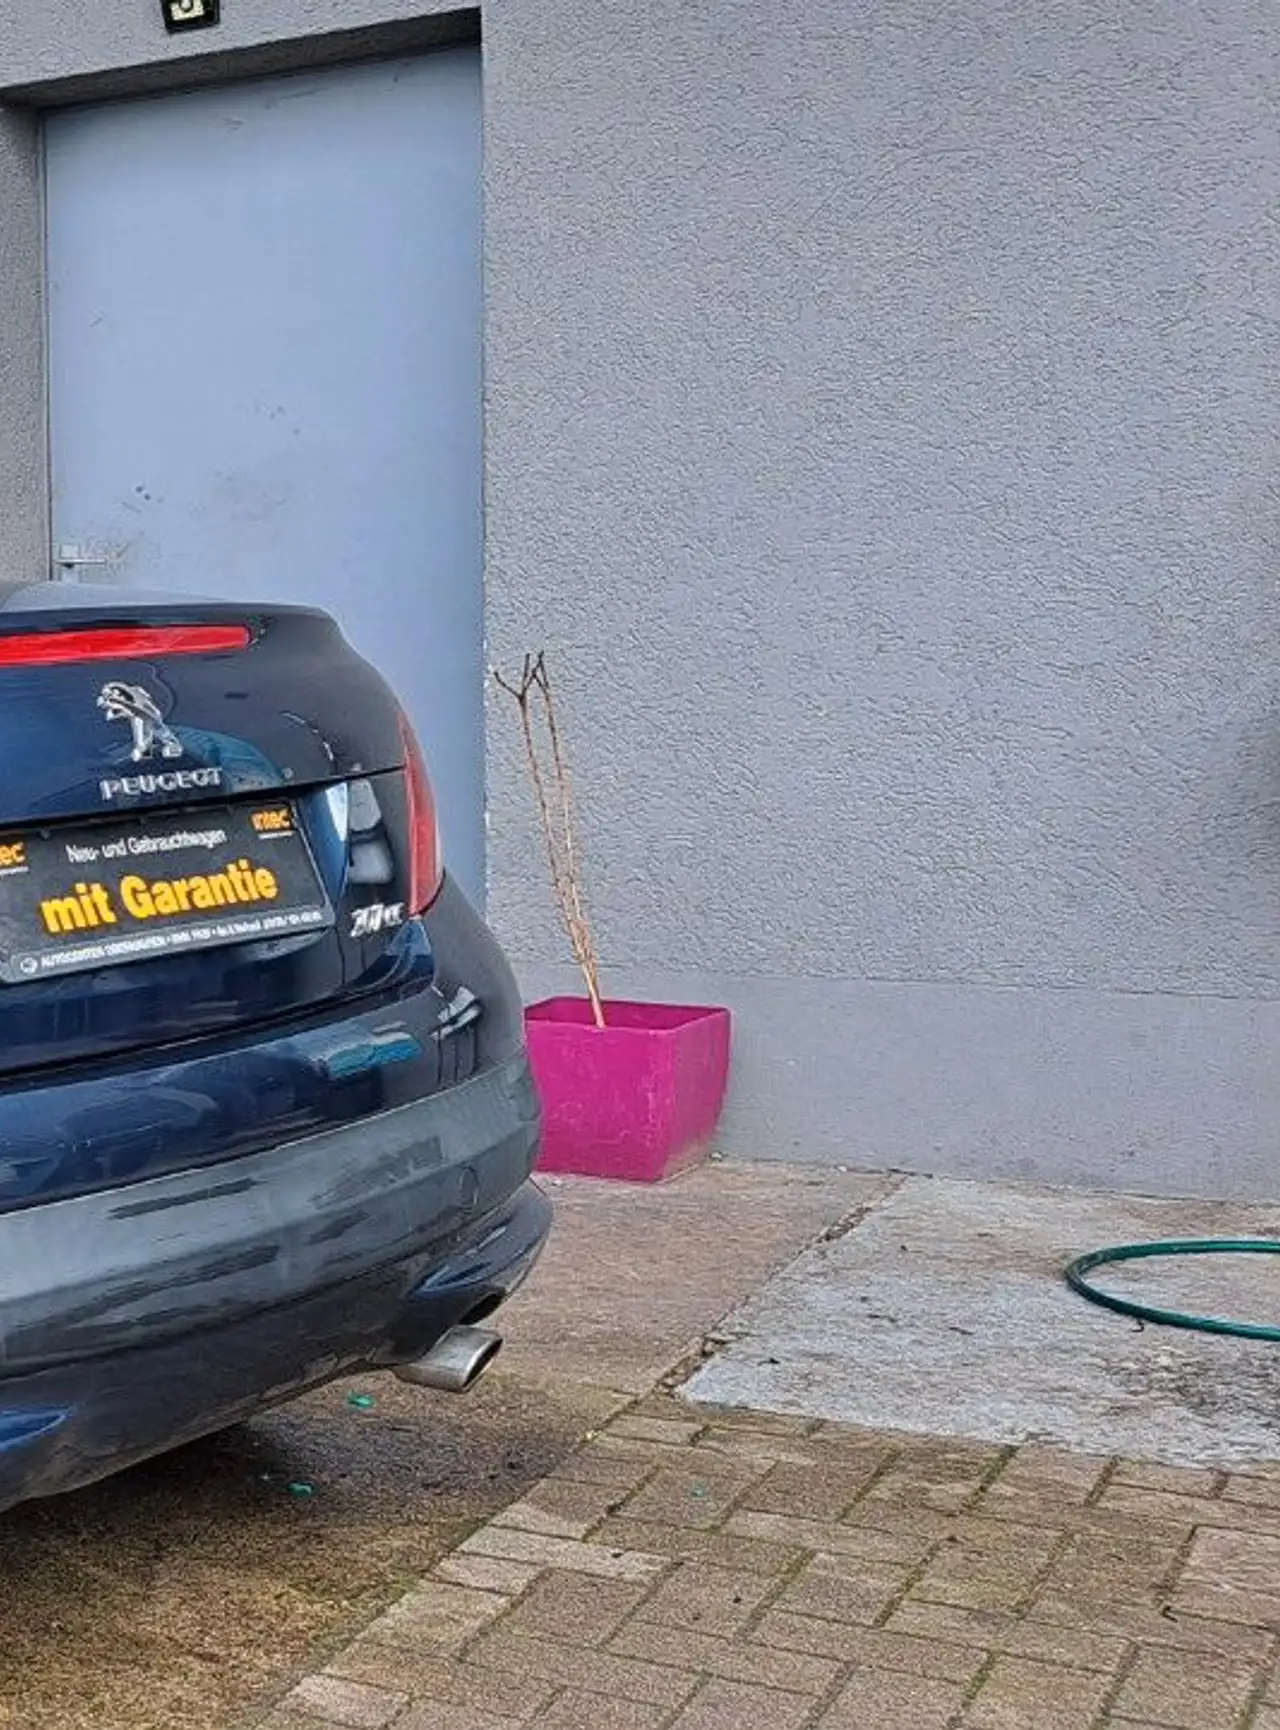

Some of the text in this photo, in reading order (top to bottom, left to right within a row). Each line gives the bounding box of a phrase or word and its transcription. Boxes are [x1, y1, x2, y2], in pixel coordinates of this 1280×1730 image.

[99, 767, 223, 801] PEUGEOT
[102, 838, 127, 858] und
[40, 880, 116, 933] mit
[119, 857, 279, 918] Garantie
